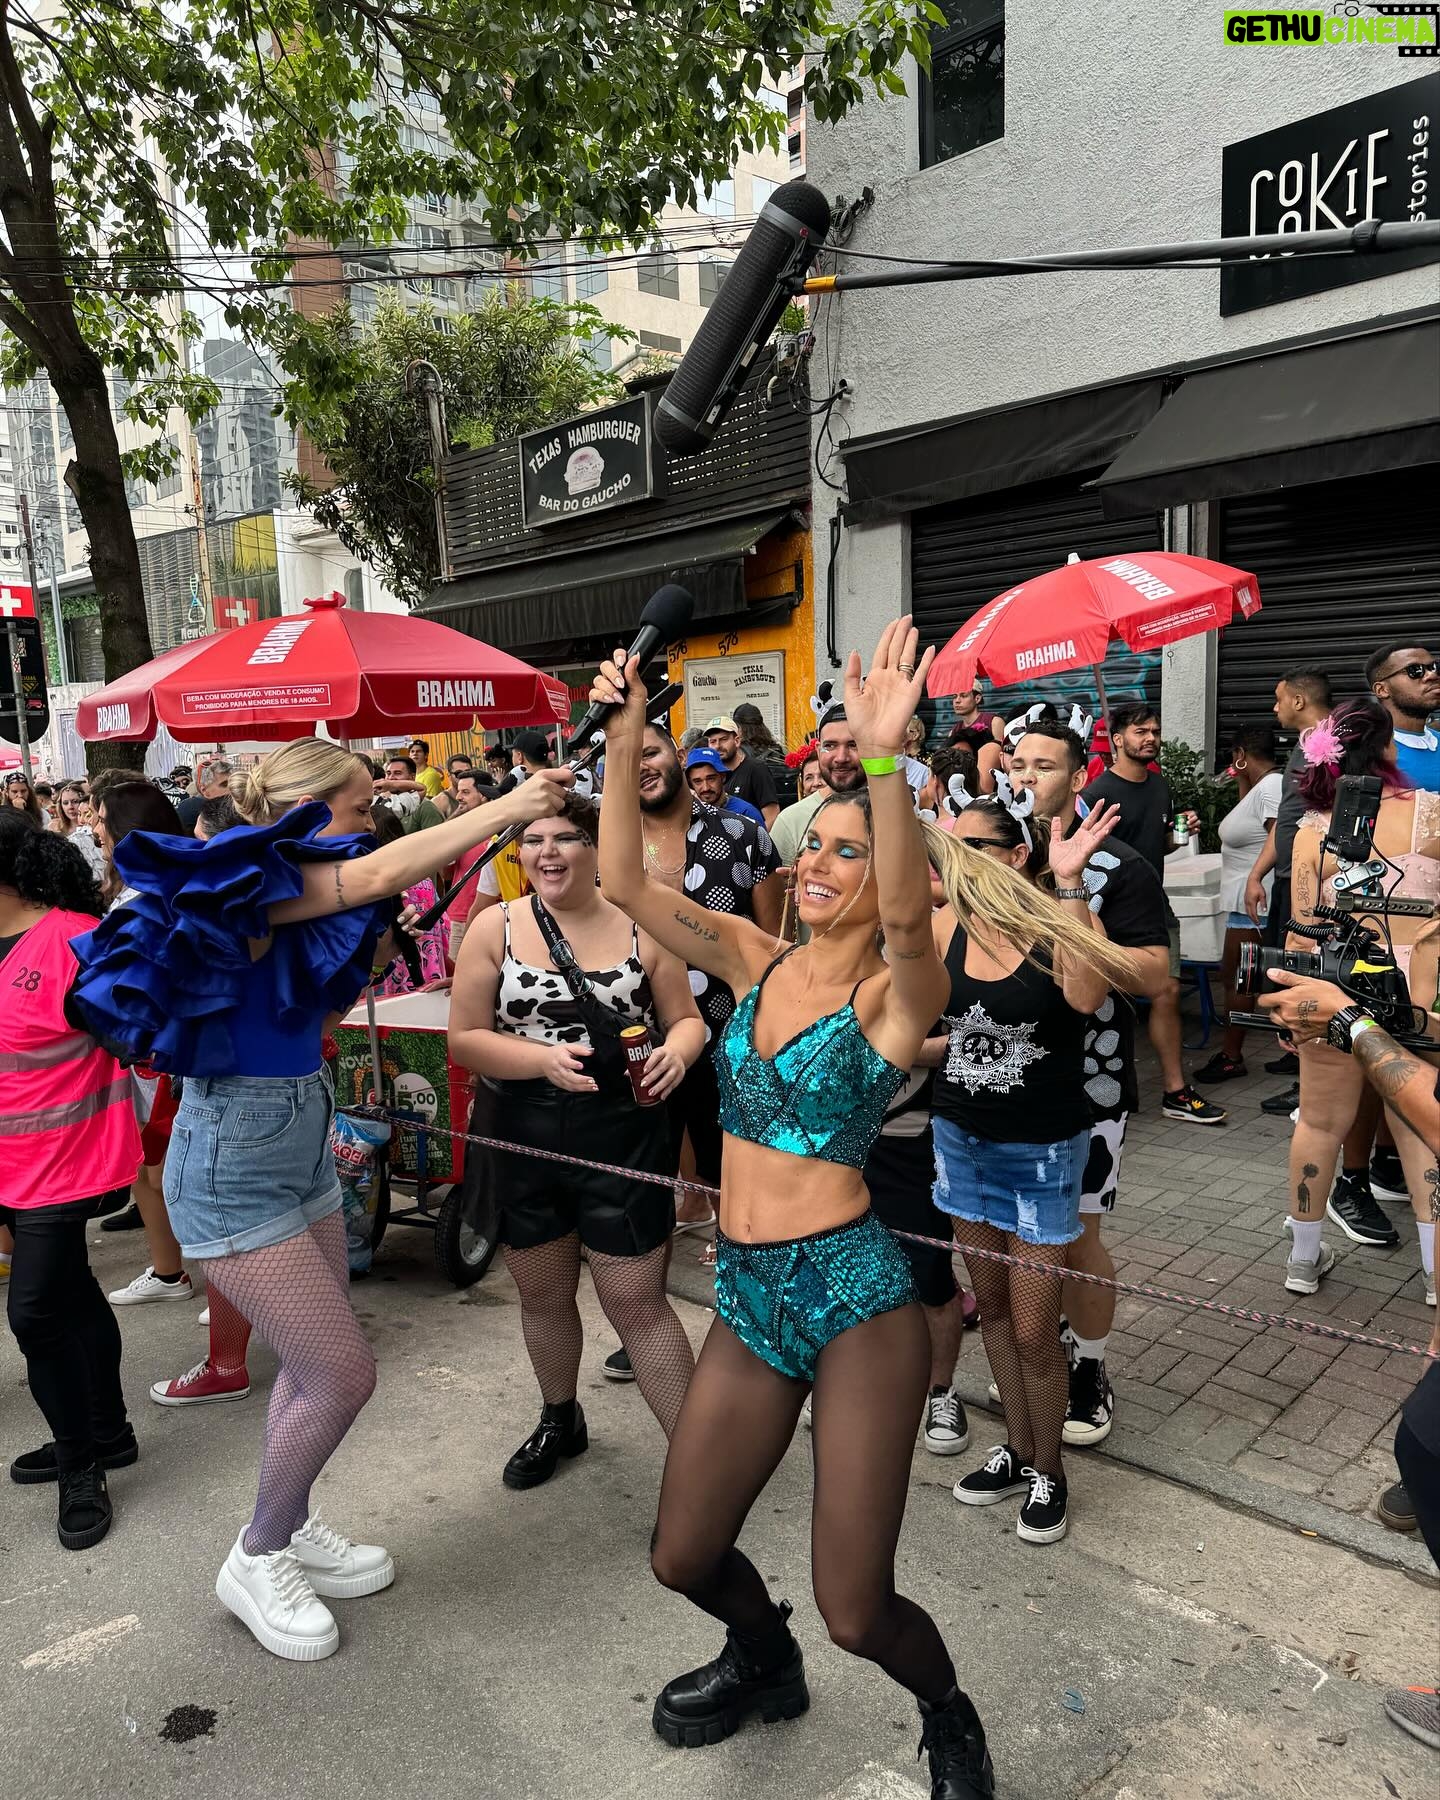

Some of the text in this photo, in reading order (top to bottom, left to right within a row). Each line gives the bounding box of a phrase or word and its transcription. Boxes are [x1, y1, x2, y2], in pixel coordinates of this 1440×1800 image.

[528, 420, 641, 475] TEXAS HAMBURGUER
[538, 473, 631, 511] BAR DO GAUCHO
[1097, 559, 1176, 601] BRAHMA
[246, 619, 316, 665] BRAHMA
[1015, 640, 1077, 671] BRAHMA
[195, 702, 230, 710] PROIBIDOS
[292, 687, 325, 695] CONSUMO
[417, 680, 496, 708] BRAHMA
[96, 703, 131, 733] BRAHMA
[11, 966, 42, 992] 28
